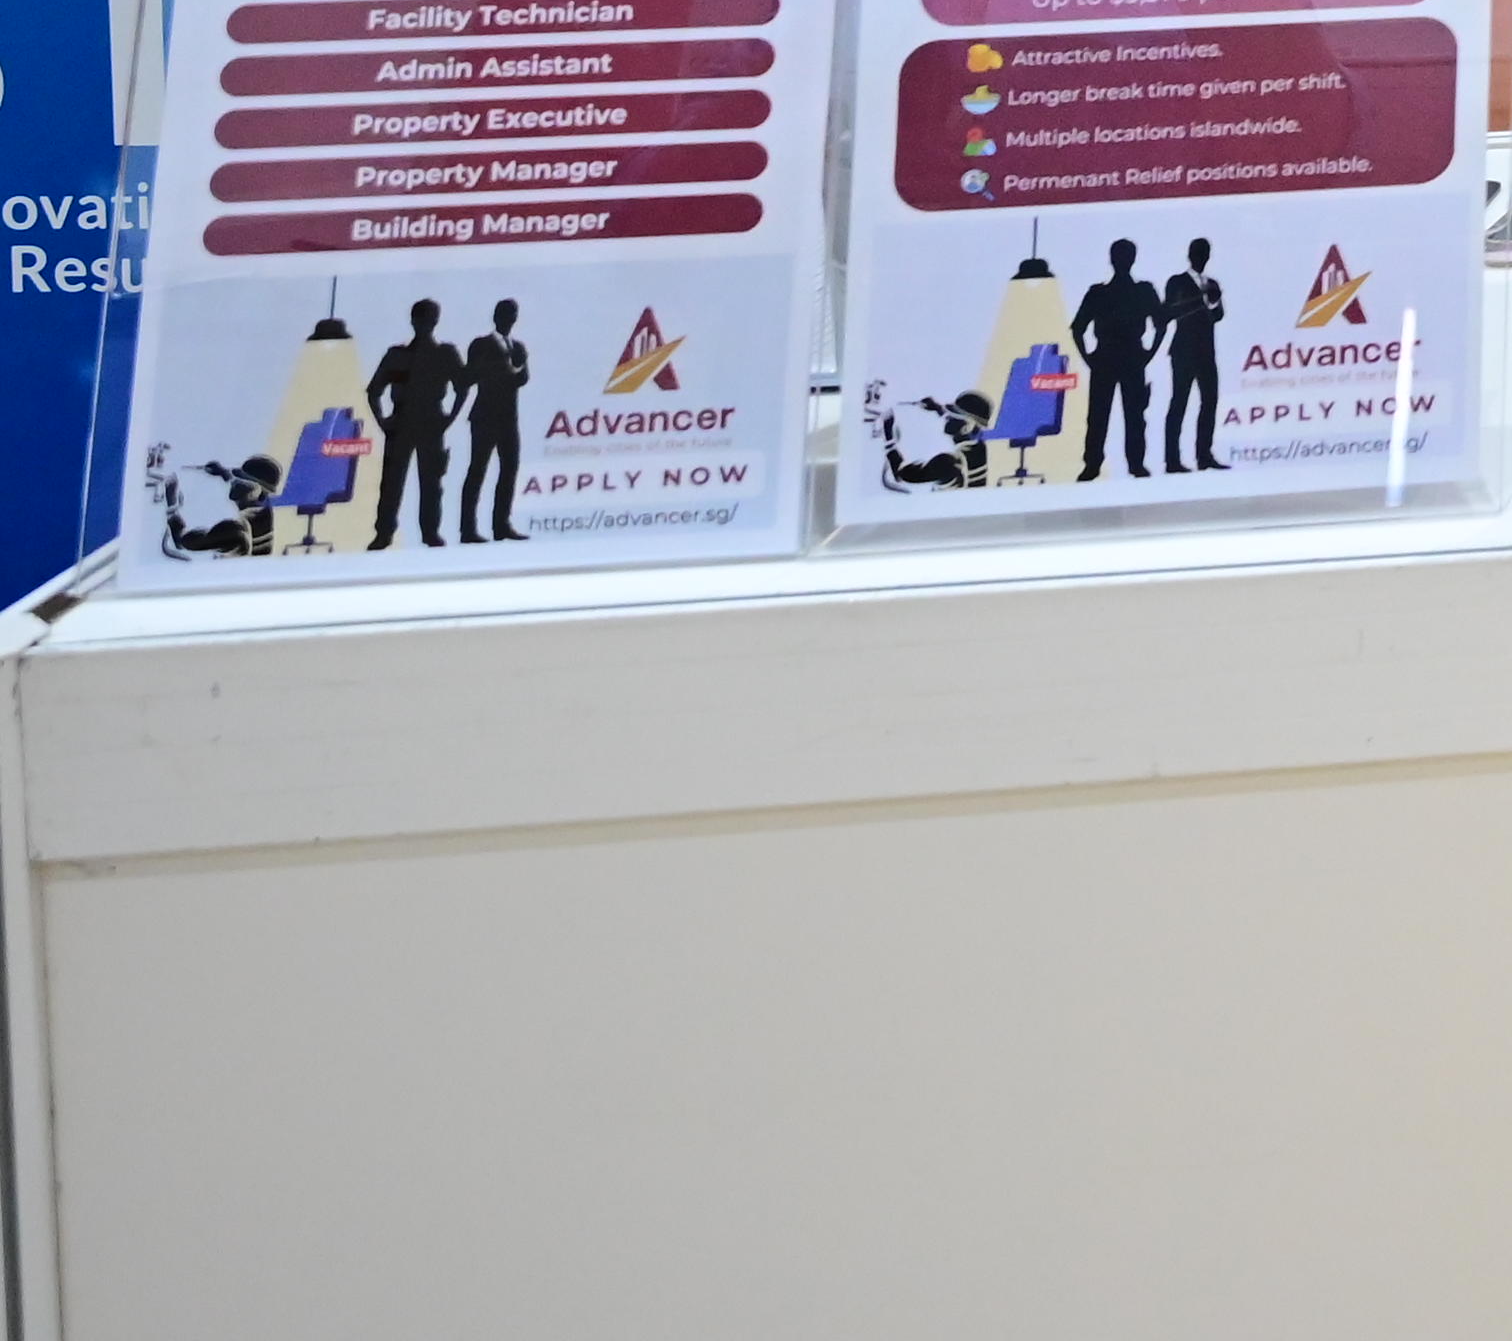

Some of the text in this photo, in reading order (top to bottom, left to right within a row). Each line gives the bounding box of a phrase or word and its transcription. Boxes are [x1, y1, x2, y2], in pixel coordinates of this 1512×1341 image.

[366, 0, 634, 34] Facility Technician
[375, 52, 613, 83] Admin Assistant
[1011, 41, 1223, 68] Attractive Incentives.
[1007, 71, 1347, 111] Longer break time given per shift.
[351, 104, 628, 141] Property Executive
[1005, 117, 1303, 151] Multiple locations islandwide.
[355, 157, 618, 191] Property Manager
[1003, 154, 1375, 194] Permenant Relief positions available.
[351, 208, 610, 243] Building Manager
[545, 406, 736, 439] Advancer
[1223, 400, 1336, 426] APPLY
[1229, 429, 1429, 464] https://advancerg/
[523, 463, 748, 495] APPLY NOW
[528, 501, 739, 533] https://advancer.sg/
